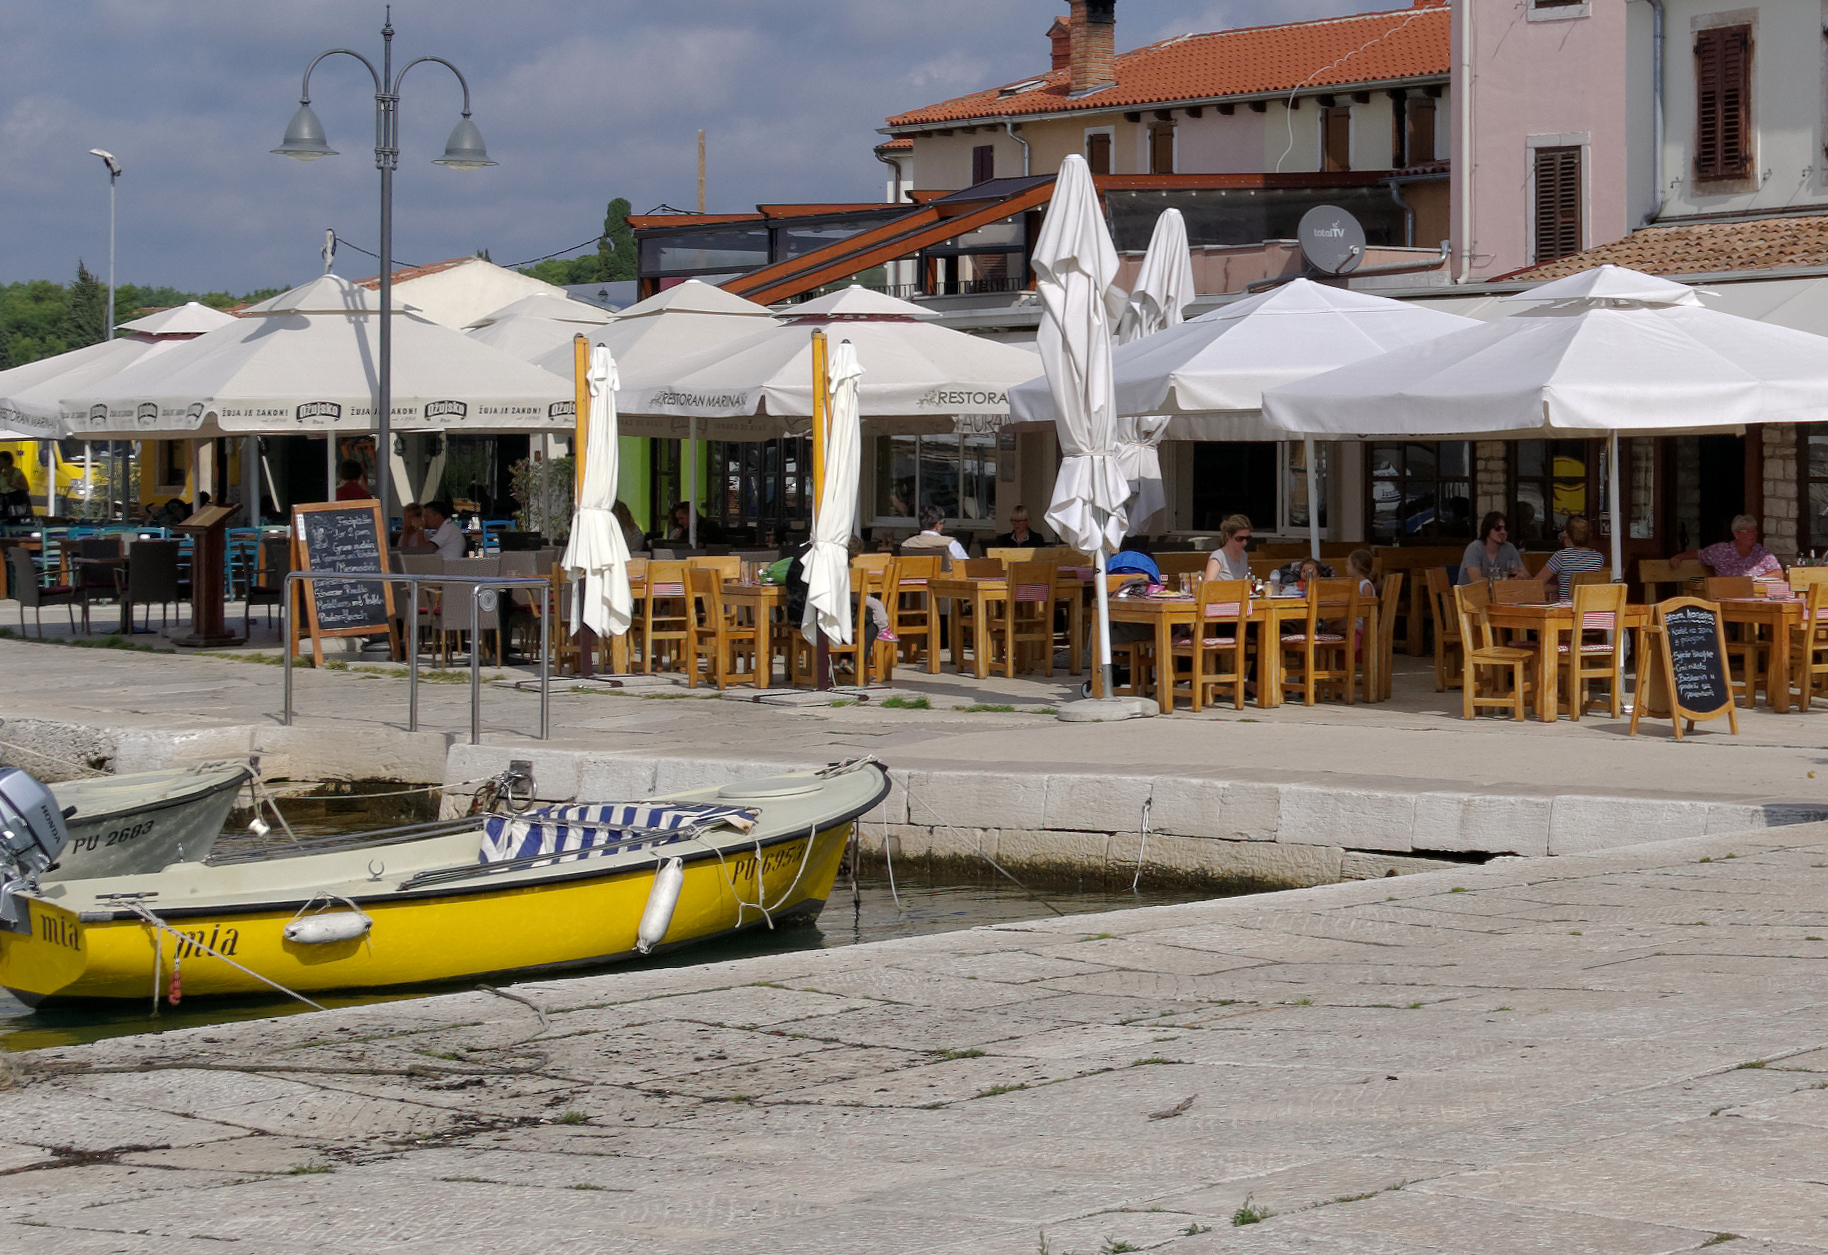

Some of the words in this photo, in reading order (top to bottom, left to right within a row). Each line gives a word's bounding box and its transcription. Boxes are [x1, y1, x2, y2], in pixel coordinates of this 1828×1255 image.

[662, 392, 706, 407] RESTORAN
[938, 391, 1010, 405] RESTORA
[255, 409, 289, 417] ZAKON!
[390, 407, 418, 415] AKON!
[40, 804, 62, 845] HONDA
[72, 833, 100, 855] PU
[731, 856, 758, 885] PU
[40, 913, 82, 953] mia
[173, 923, 240, 960] mia
